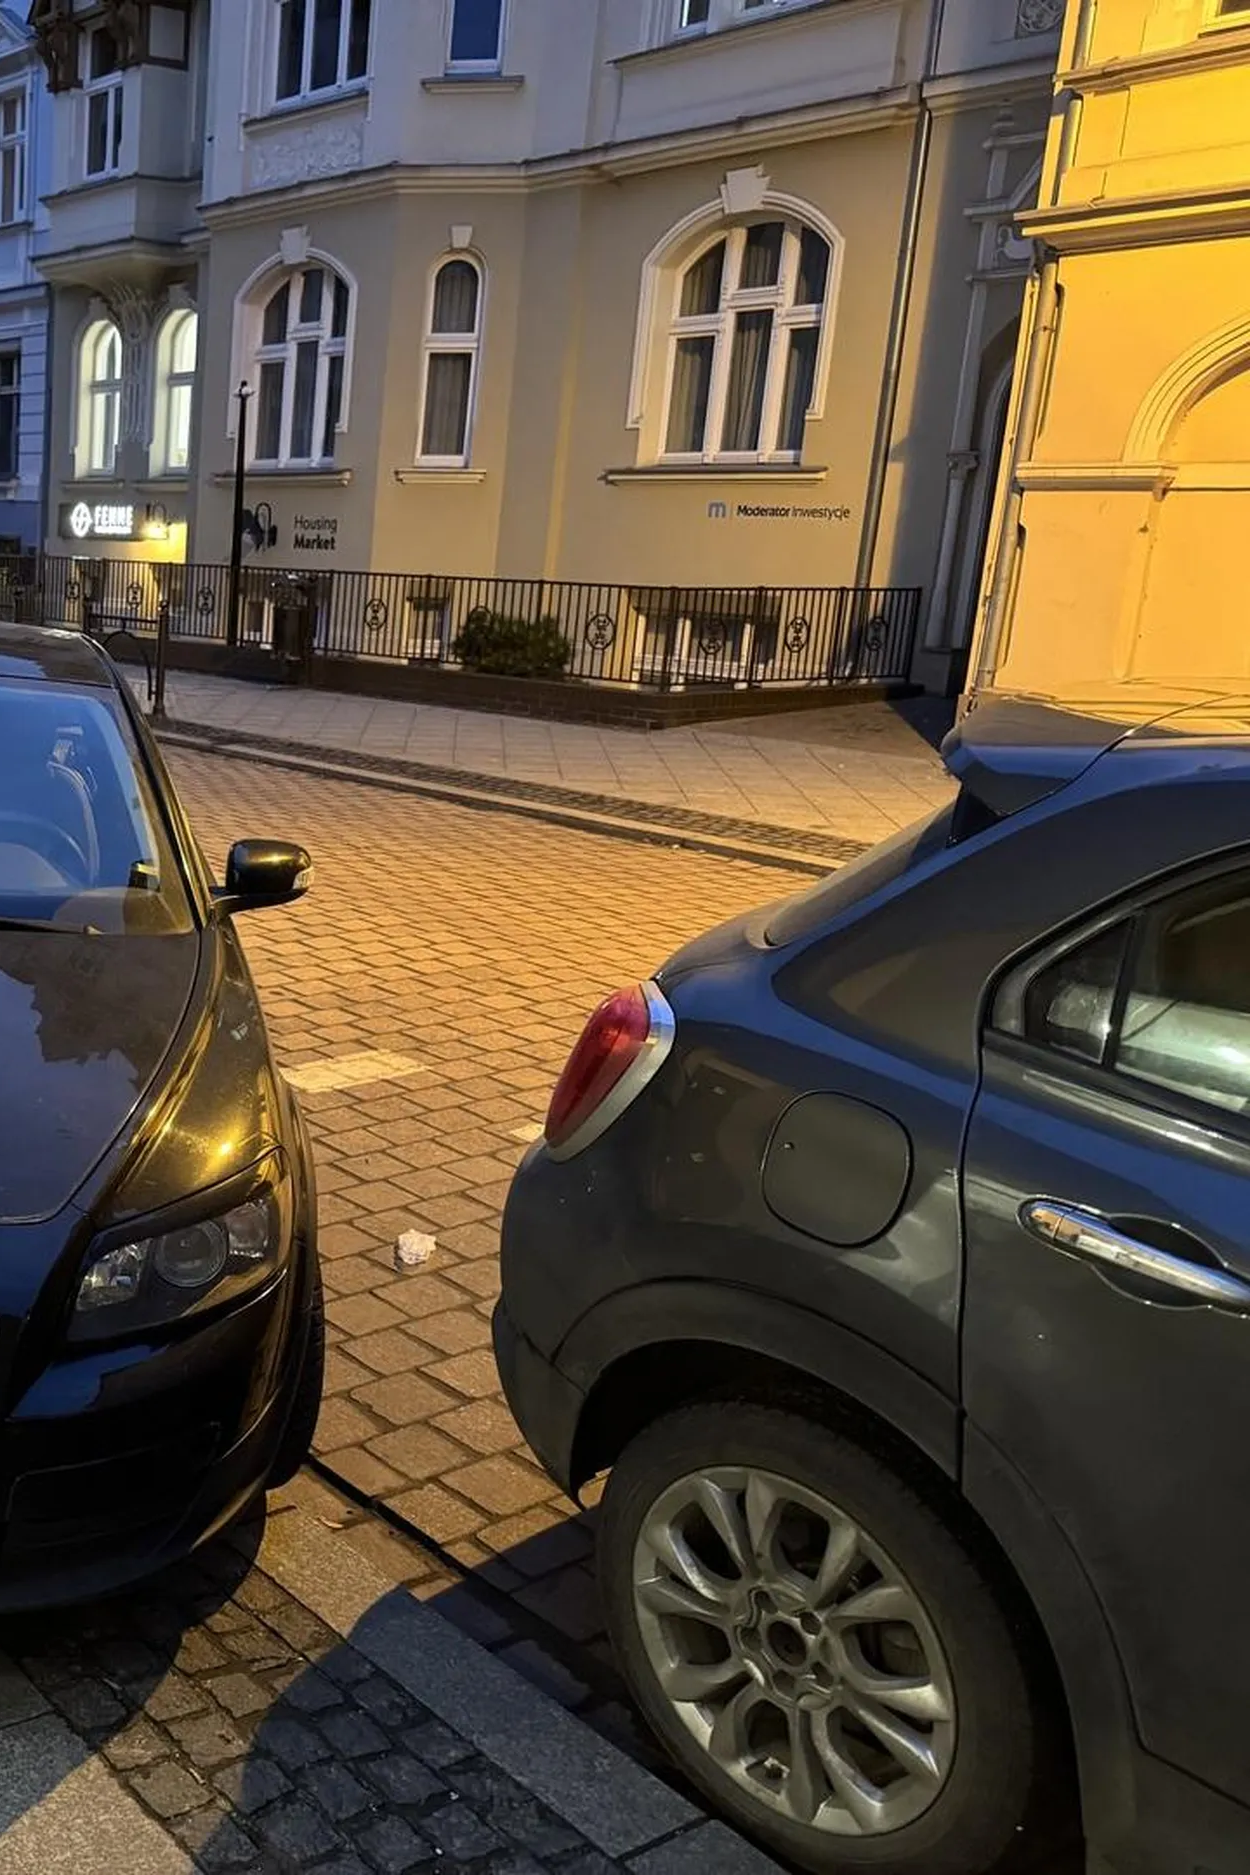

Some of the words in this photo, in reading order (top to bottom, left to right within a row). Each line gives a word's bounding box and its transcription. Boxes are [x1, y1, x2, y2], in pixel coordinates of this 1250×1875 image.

[736, 505, 790, 517] Moderator
[294, 515, 338, 534] Housing
[293, 534, 336, 550] Market
